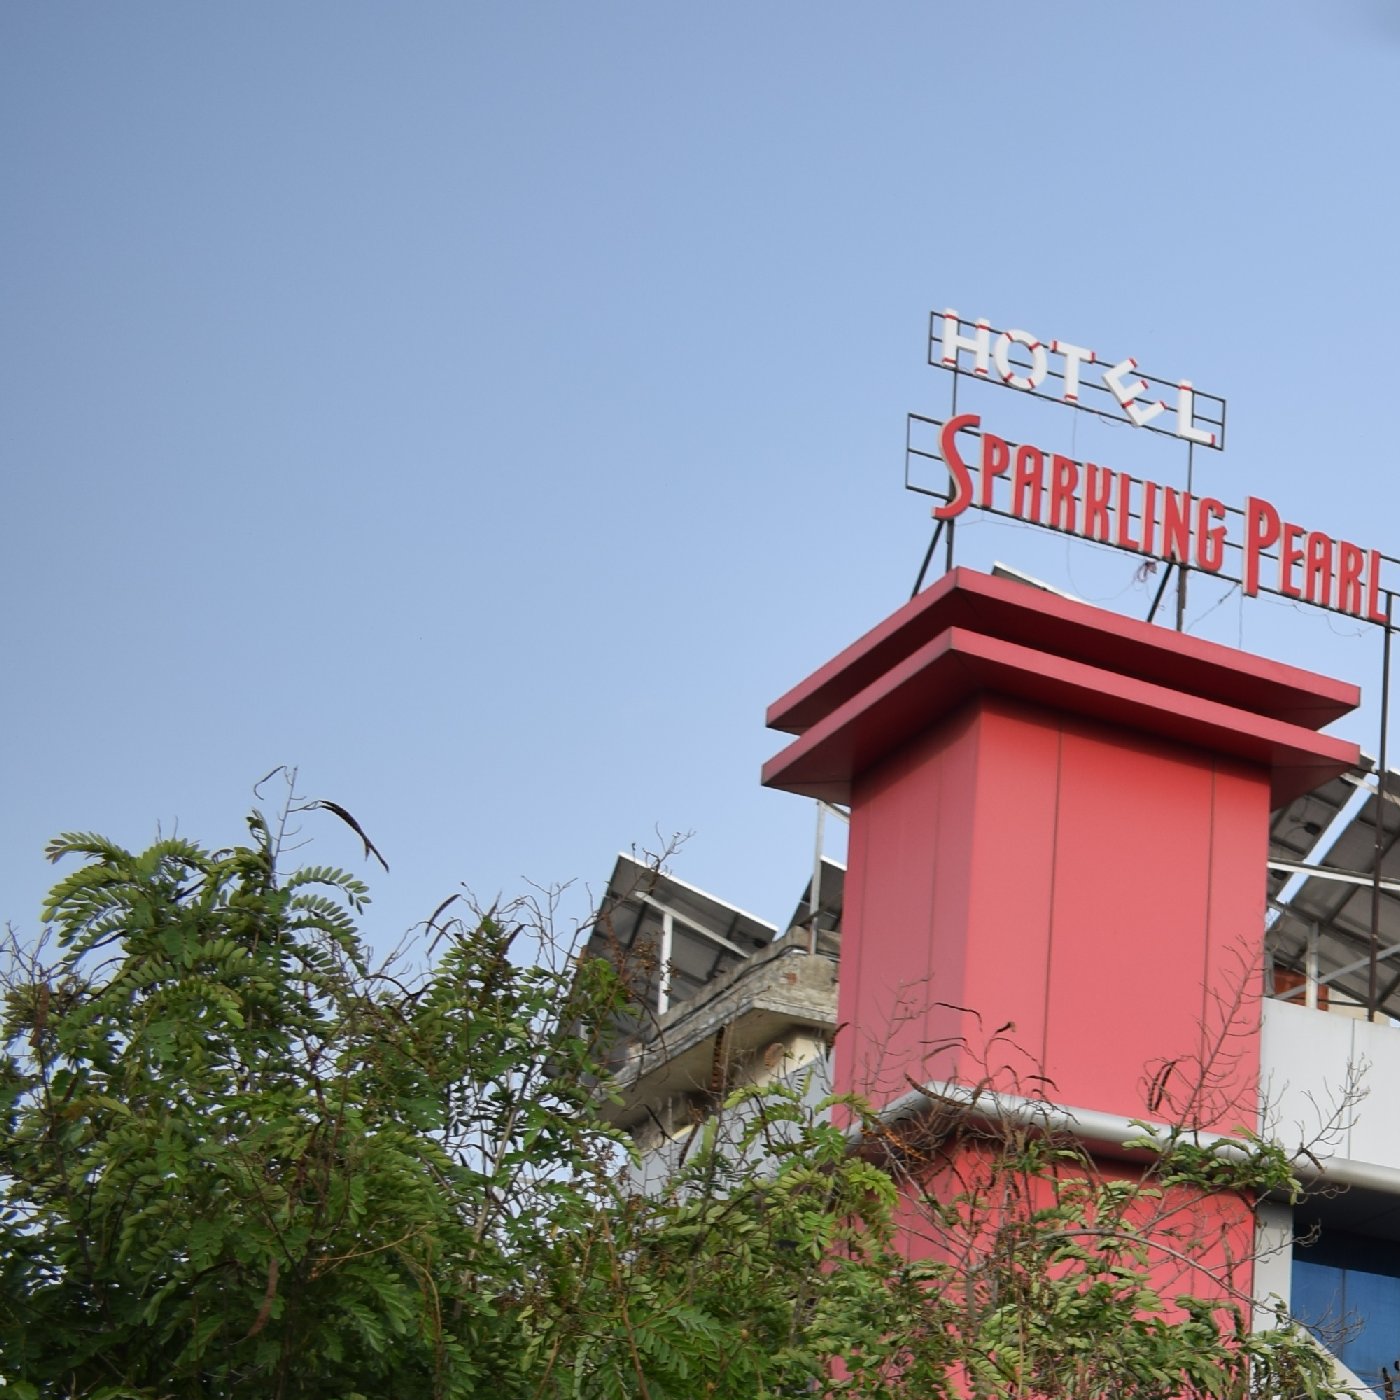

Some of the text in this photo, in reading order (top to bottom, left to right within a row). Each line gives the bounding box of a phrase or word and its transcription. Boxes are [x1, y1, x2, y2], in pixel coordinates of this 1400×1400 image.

[941, 308, 1216, 445] HOTEL
[932, 414, 1388, 623] SPARKLING PEARL
